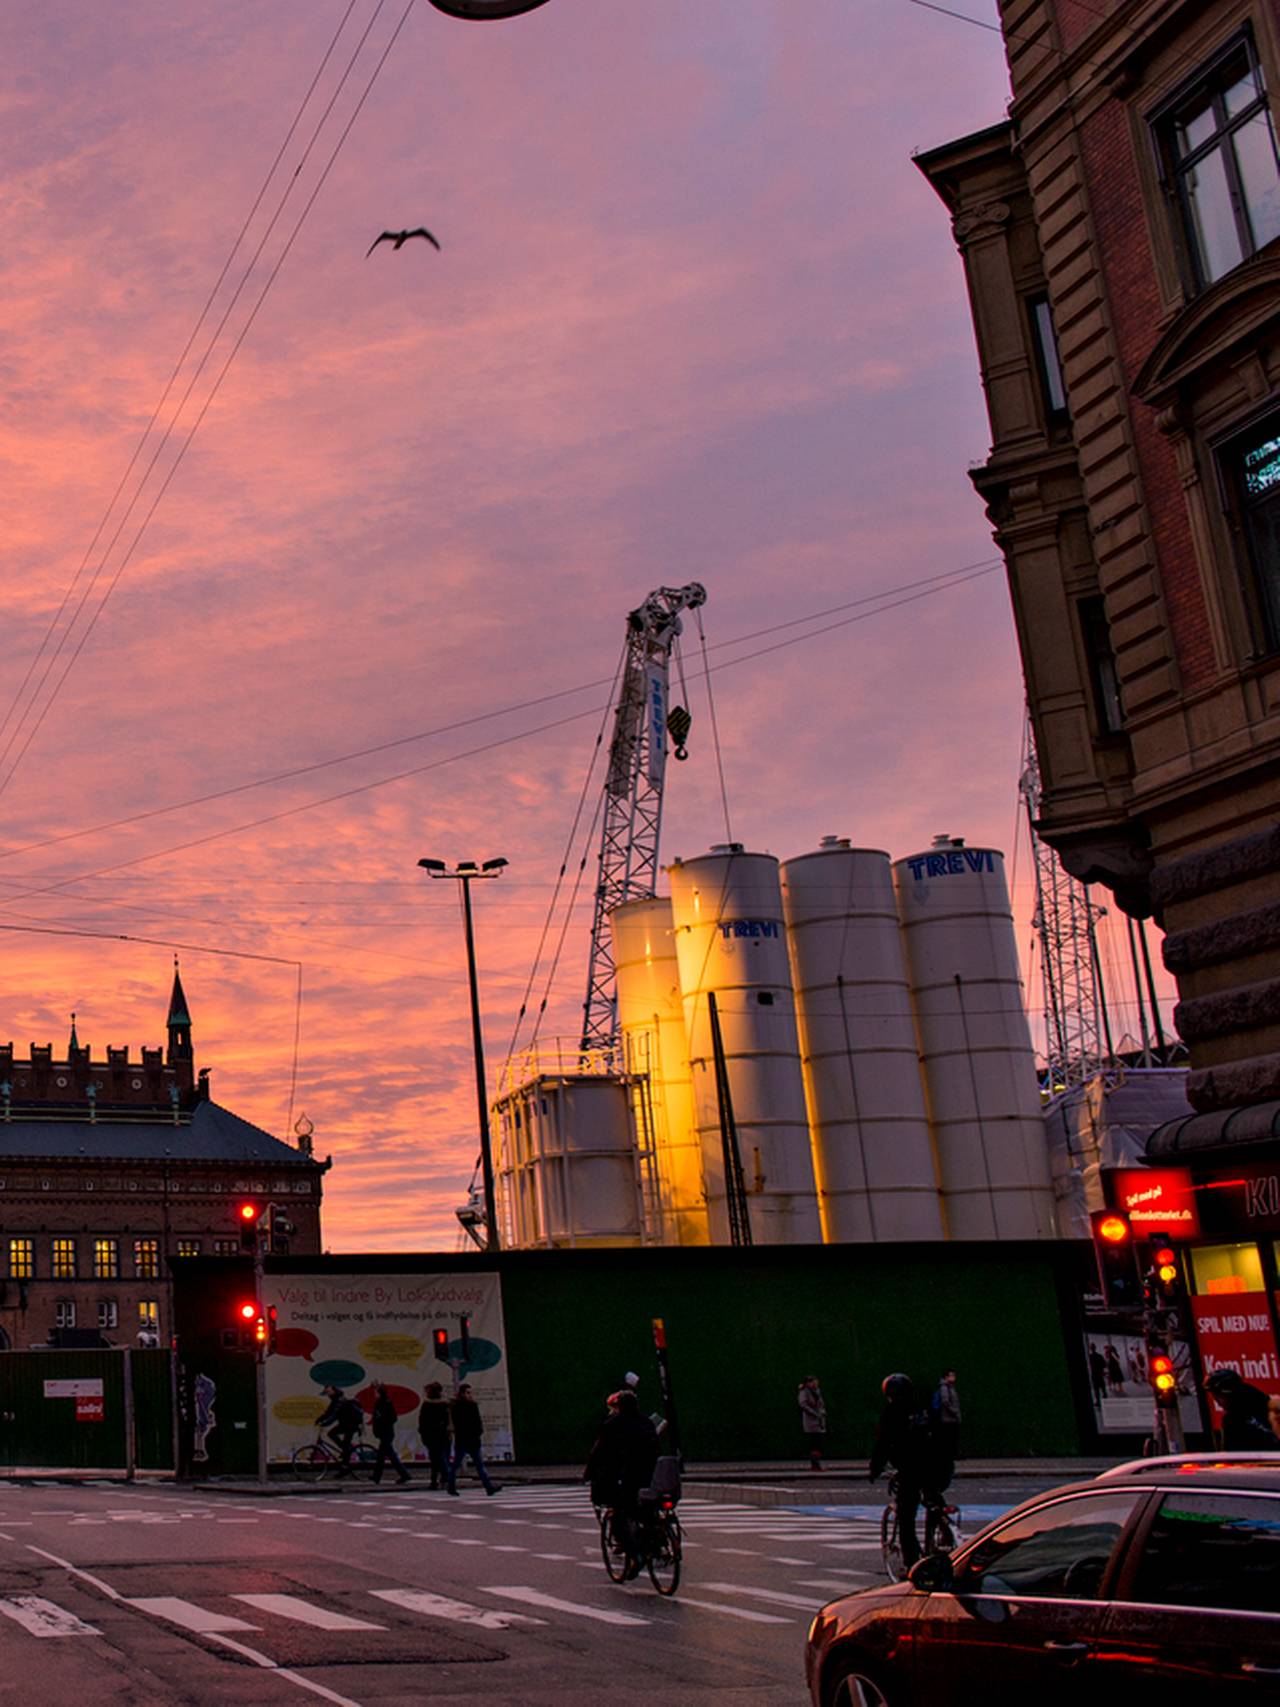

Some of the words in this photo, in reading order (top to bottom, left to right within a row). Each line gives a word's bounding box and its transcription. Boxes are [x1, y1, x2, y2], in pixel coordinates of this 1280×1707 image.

[652, 678, 663, 749] TREVI
[908, 849, 994, 880] TREVI
[718, 920, 778, 938] TREVI
[278, 1287, 309, 1307] Valg
[314, 1287, 327, 1303] til
[332, 1287, 369, 1303] Indre
[374, 1287, 393, 1305] By
[398, 1286, 485, 1305] Lokaludvalg
[291, 1311, 319, 1322] Deltag
[1198, 1317, 1221, 1334] SPIL
[1222, 1315, 1246, 1332] MED
[1248, 1314, 1270, 1331] NU!
[1241, 1353, 1270, 1379] ind
[1270, 1353, 1279, 1379] i
